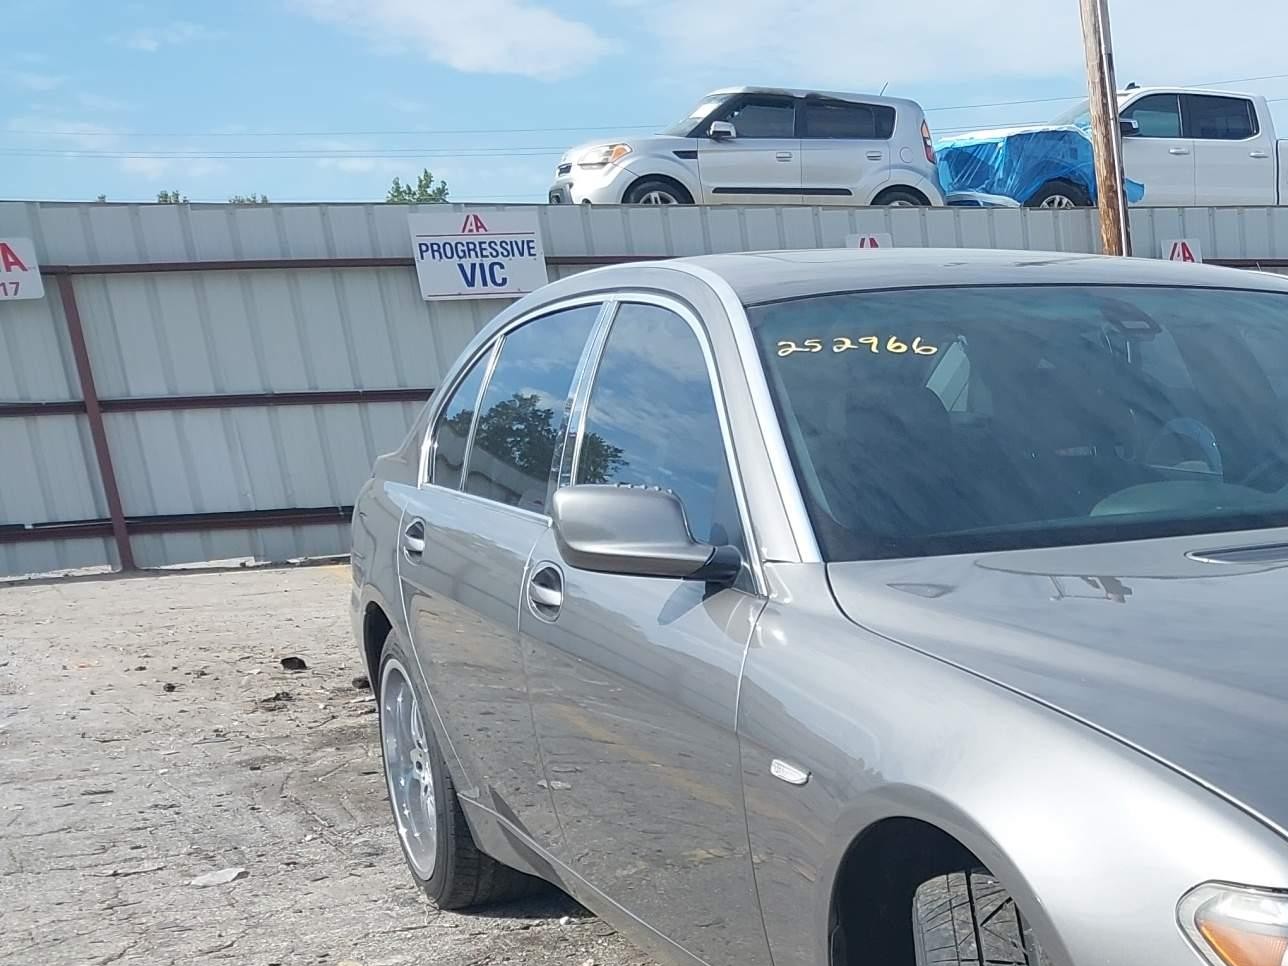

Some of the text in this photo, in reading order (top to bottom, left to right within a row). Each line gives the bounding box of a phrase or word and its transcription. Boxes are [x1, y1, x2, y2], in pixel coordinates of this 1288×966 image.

[418, 240, 537, 260] PROGRESSIVE
[457, 261, 508, 288] VIC
[0, 281, 20, 297] 17
[776, 335, 938, 357] 252966
